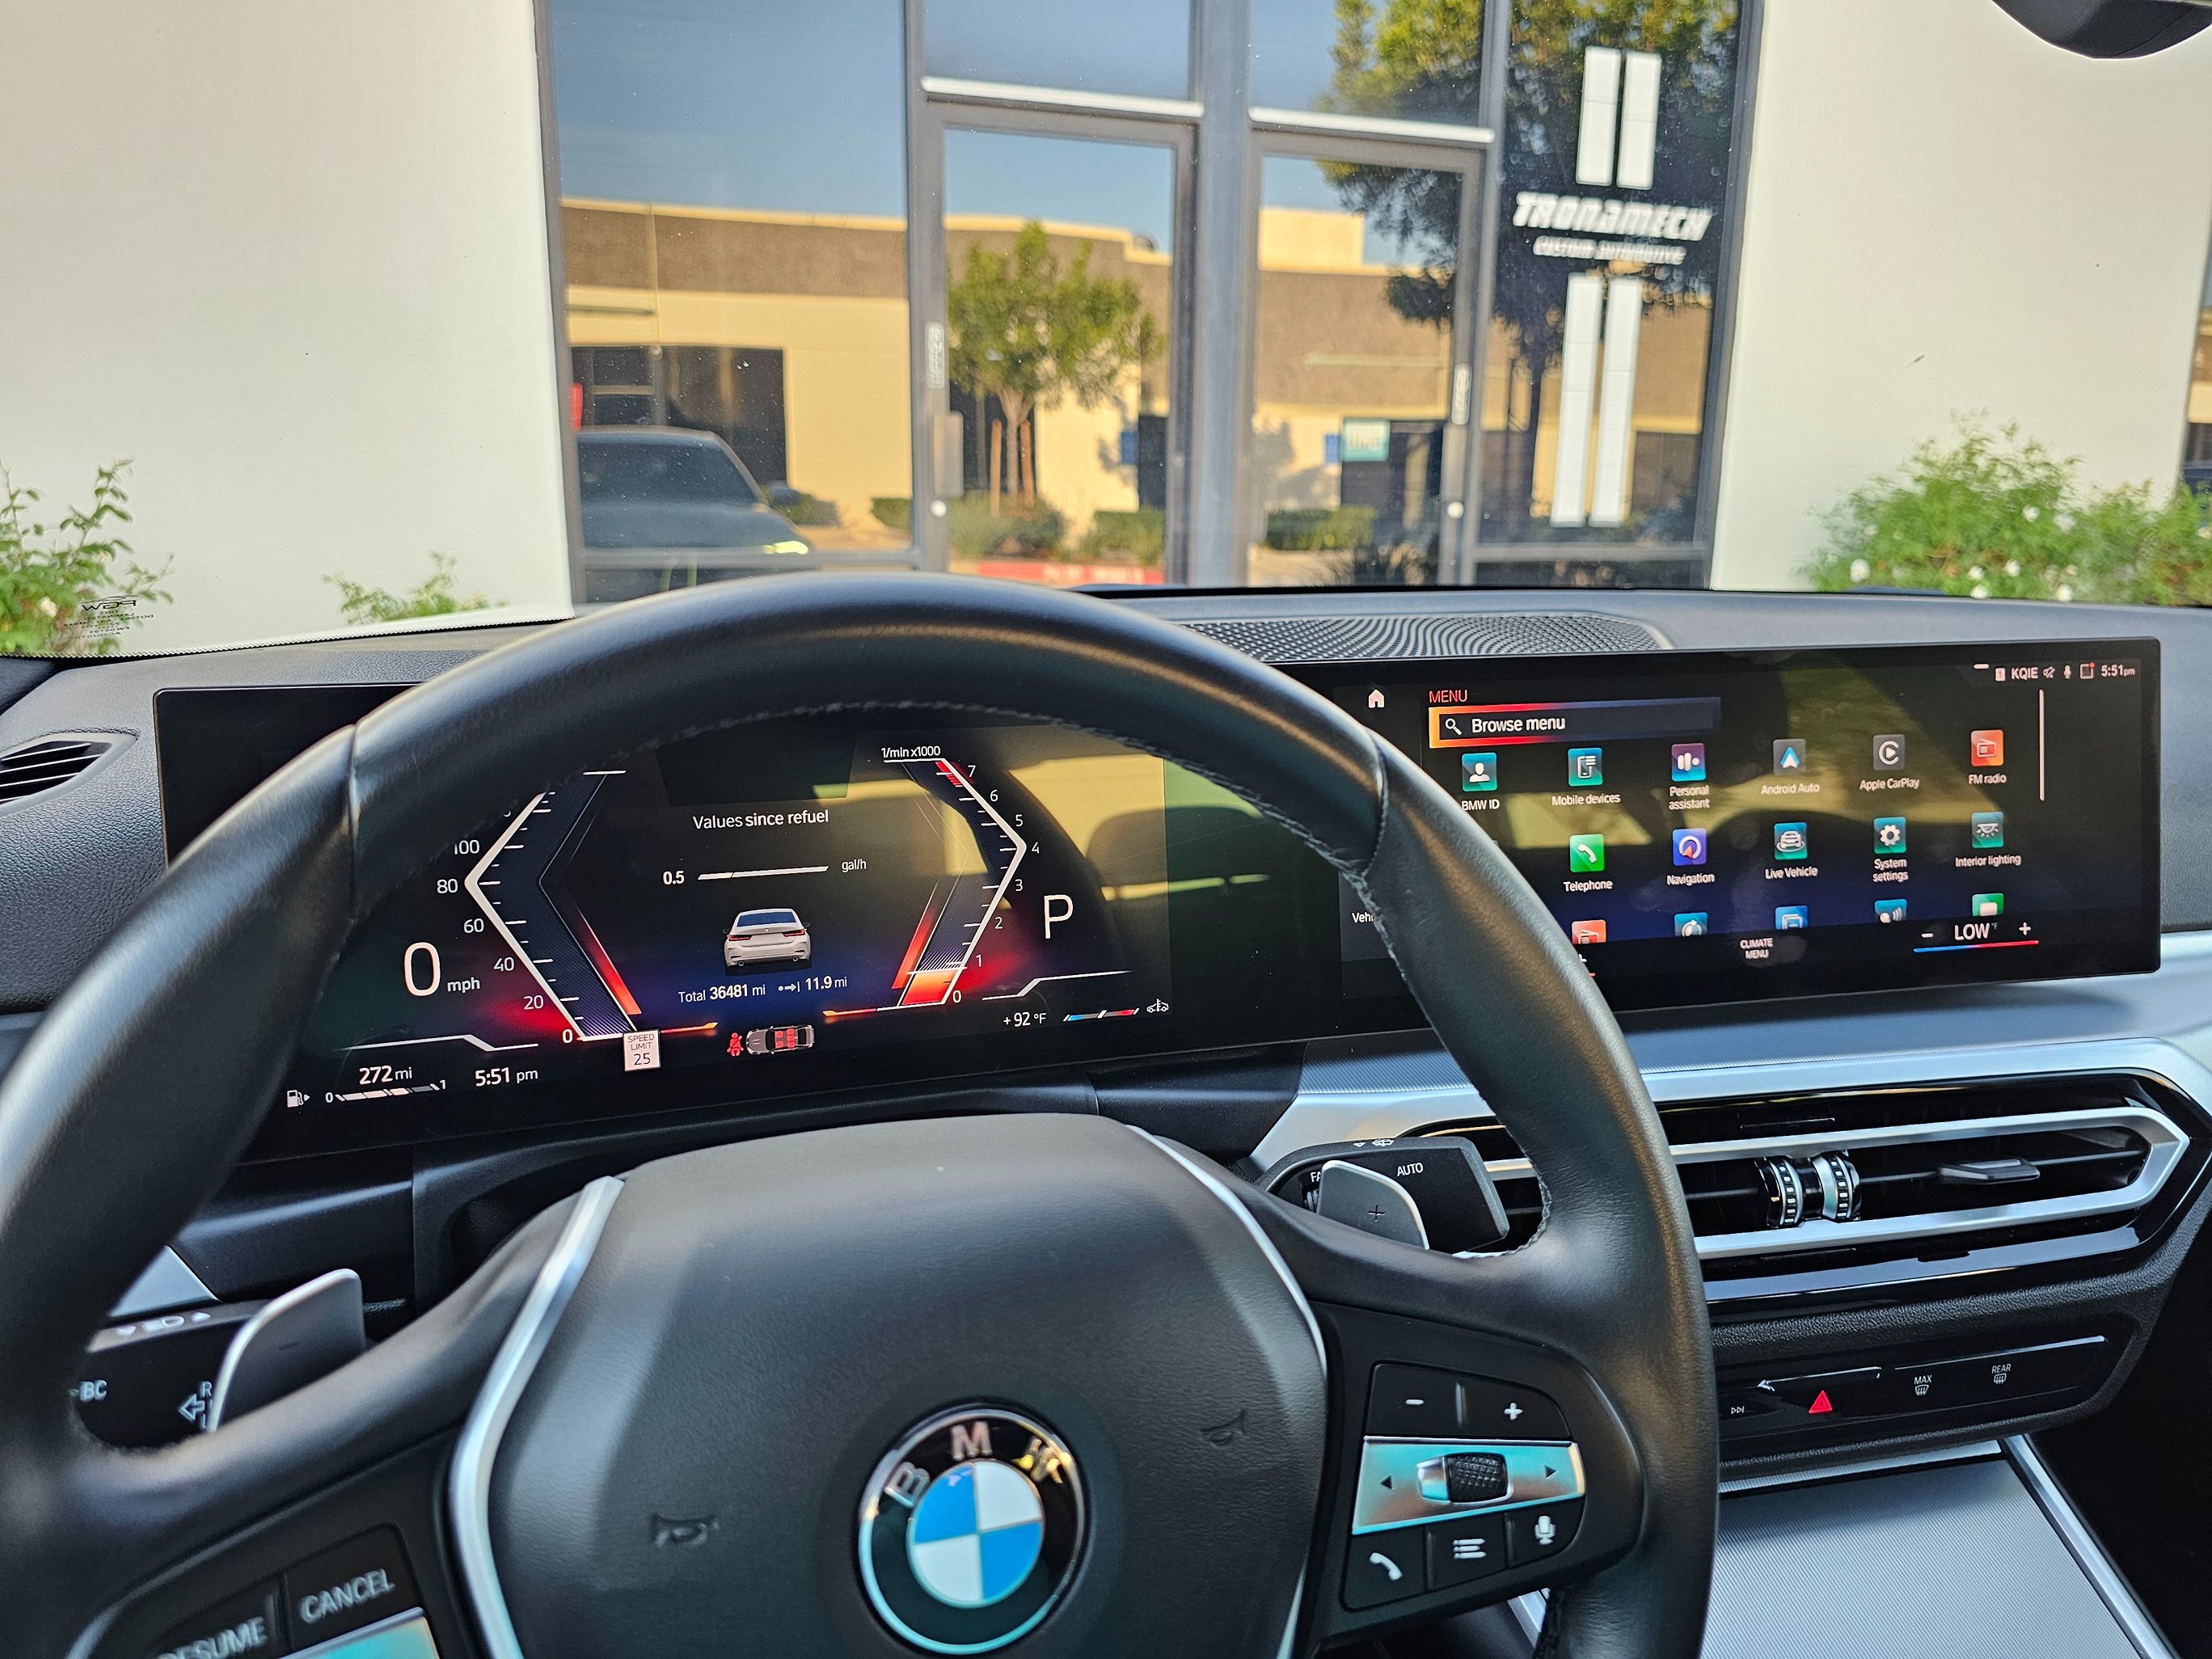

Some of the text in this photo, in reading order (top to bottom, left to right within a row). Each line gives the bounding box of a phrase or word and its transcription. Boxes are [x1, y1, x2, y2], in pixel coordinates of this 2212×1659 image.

[2011, 666, 2038, 680] KQIE
[1429, 690, 1468, 703] MENU
[1471, 717, 1566, 733] Browse menu
[881, 745, 940, 759] 1/min x1000
[968, 765, 977, 778] 7
[1860, 777, 1920, 792] Apple CarPlay
[1968, 773, 2007, 785] FM radio
[990, 790, 999, 802] 6
[1670, 784, 1710, 797] Personal
[1760, 783, 1820, 796] Android Auto
[1462, 799, 1501, 811] BMW ID
[1551, 793, 1622, 806] Mobile devices
[1669, 798, 1710, 810] assistant
[693, 809, 829, 830] Values since refuel
[1015, 815, 1024, 828] 5
[1031, 842, 1041, 855] 4
[842, 859, 867, 873] gal/h
[1874, 858, 1907, 871] System
[1955, 855, 2021, 867] Interior lighting
[663, 871, 685, 884] 0.5
[1666, 872, 1716, 887] Navigation
[1765, 866, 1818, 880] Live Vehicle
[1872, 870, 1909, 883] settings
[437, 878, 458, 893] 80
[1015, 879, 1024, 892] 3
[1563, 880, 1614, 893] Telephone
[1043, 894, 1074, 939] P
[463, 918, 484, 933] 60
[994, 917, 1003, 930] 2
[1954, 923, 1990, 940] LOW
[1740, 938, 1773, 949] CLIMATE
[976, 955, 982, 967] 1
[1746, 949, 1769, 960] MENU
[404, 942, 480, 996] 0 mph
[494, 957, 515, 971] 40
[678, 976, 847, 1003] Total 36481 mi 11.9 mi
[524, 995, 544, 1010] 20
[952, 990, 962, 1003] 0
[562, 1028, 573, 1043] 0
[627, 1033, 655, 1043] SPEED
[631, 1042, 652, 1051] LIMIT
[634, 1053, 651, 1066] 25
[359, 1065, 412, 1085] 272 mi
[475, 1067, 538, 1087] 5:51 pm
[325, 1091, 334, 1104] 0
[1396, 1162, 1424, 1177] AUTO
[1991, 1363, 2011, 1374] REAR
[1914, 1374, 1932, 1385] MAX
[884, 1420, 1066, 1508] BMW
[299, 1568, 396, 1624] CANCEL
[158, 1617, 268, 1659] SUME
